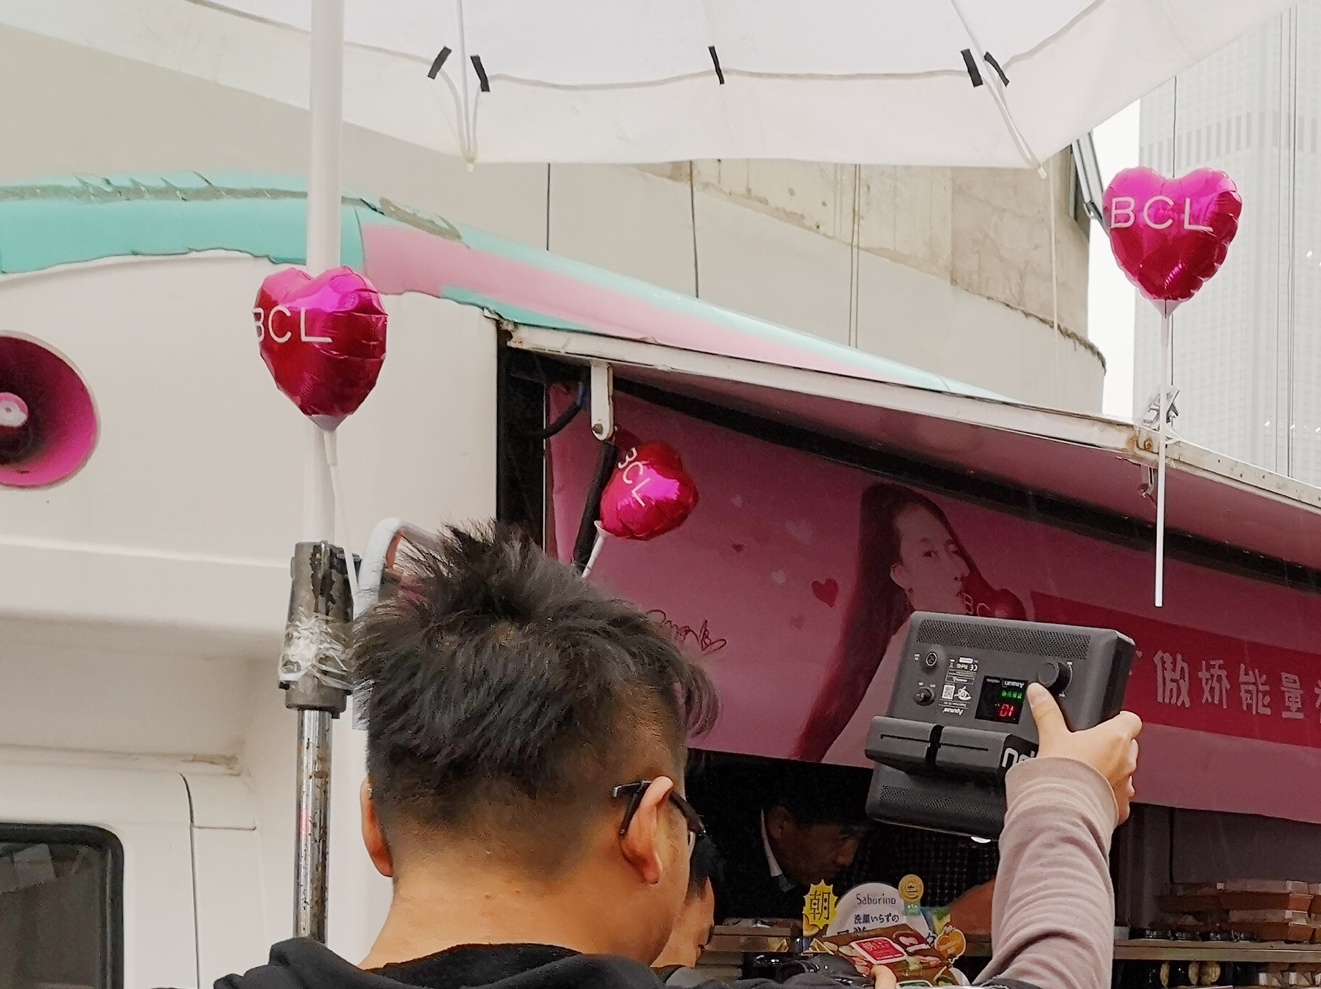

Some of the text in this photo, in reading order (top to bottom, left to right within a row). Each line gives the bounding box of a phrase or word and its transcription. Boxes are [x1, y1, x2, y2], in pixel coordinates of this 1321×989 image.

[1110, 195, 1213, 232] BCL
[809, 890, 831, 921] 朝
[855, 893, 897, 905] Saborino
